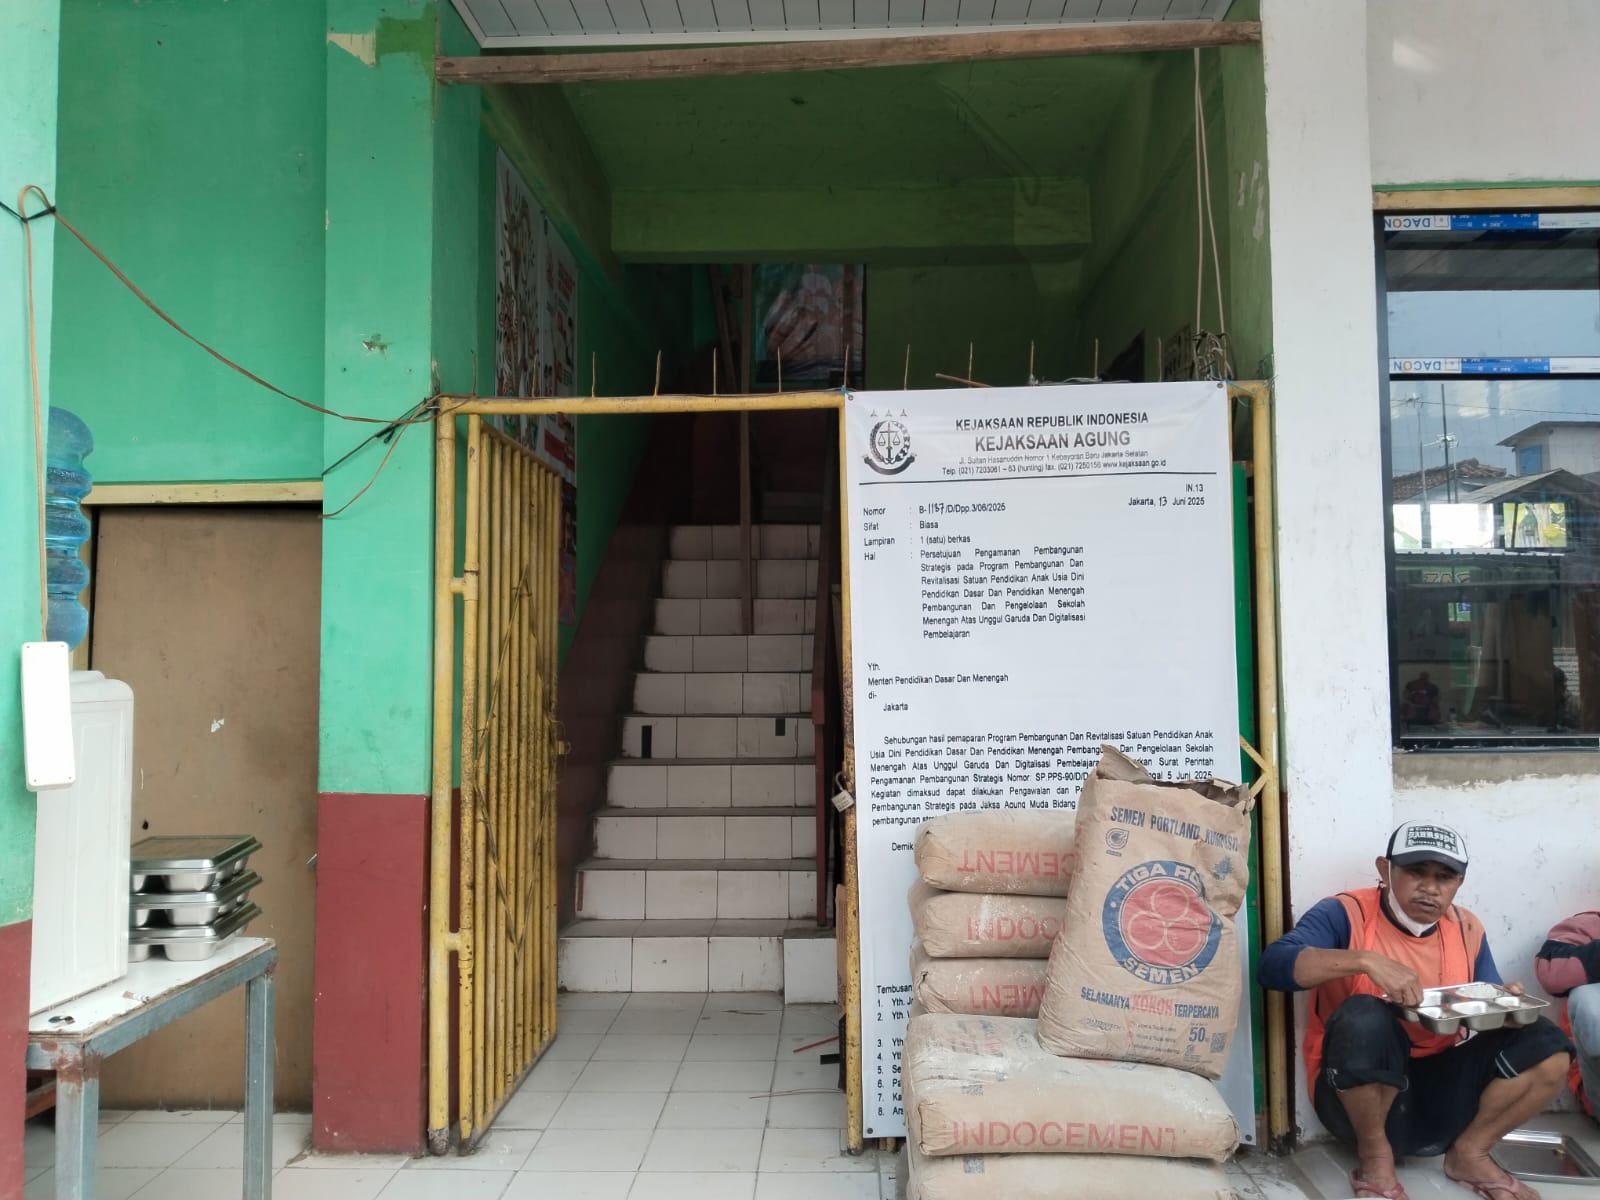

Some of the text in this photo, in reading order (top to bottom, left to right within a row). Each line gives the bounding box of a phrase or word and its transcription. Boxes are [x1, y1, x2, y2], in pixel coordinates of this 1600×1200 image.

[1384, 217, 1431, 228] DACON
[1393, 360, 1442, 371] DACON
[955, 411, 1149, 431] KEJAKSAAN REPUBLIK INDONESIA
[975, 430, 1131, 452] KEJAKSAAN AGUNG
[1172, 497, 1186, 506] Juni
[1187, 497, 1205, 506] 2025
[863, 508, 886, 516] Nomor
[863, 520, 939, 531] Sifat Biasa
[864, 537, 895, 547] Lampiran
[926, 536, 946, 545] (satu)
[948, 536, 971, 544] berkas
[864, 546, 1084, 560] Hal Persetujuan Pengamanan Pembangunan
[920, 558, 1084, 573] Strategis pada Program Pembangunan Dan
[921, 572, 1085, 585] Revitalisasi Satuan Pendidikan Anak Usia Dini
[922, 586, 1085, 598] Pendidikan Dasar Dan Pendidikan Menengah
[922, 600, 1086, 613] Pembangunan Dan Pengelolaan Sekolah
[922, 612, 1086, 626] Menengah Atas Unggul Garuda Dan Digitalisasi
[923, 630, 971, 640] Pembelajaran
[867, 662, 880, 671] Yth.
[868, 673, 1009, 686] Menteri Pendidikan Dasar Dan Menengah
[883, 702, 909, 712] Jakarta
[884, 730, 1214, 746] Sehubungan hasil pemaparan Program Pembangunan Dan Revitalisasi Satuan Pendidikan Anak
[870, 744, 1214, 759] Usia Dini Pendidikan Dasar Dan Pendidikan Menengah Pembangu Dan Pengelolaan Sekolah
[870, 762, 906, 773] Menengah
[912, 762, 928, 770] Atas
[933, 760, 958, 772] Unggul
[964, 760, 990, 770] Garuda
[996, 760, 1010, 769] Dan
[1016, 760, 1051, 770] Digitalisasi
[1056, 759, 1099, 770] Pembelajara
[1158, 756, 1179, 766] Surat
[1184, 757, 1214, 766] Perintah
[870, 776, 916, 786] Pengamanan
[920, 774, 970, 784] Pembangunan
[972, 774, 1004, 784] Strategis
[1167, 770, 1172, 780] 5
[1176, 770, 1190, 780] Juni
[870, 790, 901, 800] Kegiatan
[906, 788, 940, 797] dimaksud
[946, 788, 966, 798] dapat
[971, 787, 1004, 796] dilakukan
[1009, 786, 1051, 796] Pengawalan
[1056, 786, 1070, 794] dan
[872, 802, 921, 812] Pembangunan
[924, 802, 956, 812] Strategis
[960, 801, 977, 812] pada
[980, 801, 1001, 810] Jaksa
[1030, 800, 1049, 808] Muda
[1052, 799, 1076, 810] Bidang
[872, 817, 920, 827] pembangunan
[1110, 806, 1146, 828] SEMEN
[1150, 814, 1200, 841] PORTLAND
[892, 842, 914, 851] Demik
[957, 850, 1076, 878] CEMENT
[1116, 863, 1202, 891] TIGA RO
[1123, 956, 1199, 985] SEMEN
[1080, 986, 1131, 1011] SELAMANYA
[1174, 1003, 1220, 1019] TERPERCAYA
[1188, 1026, 1206, 1042] 50
[953, 1121, 1177, 1153] INDOCEMENT
